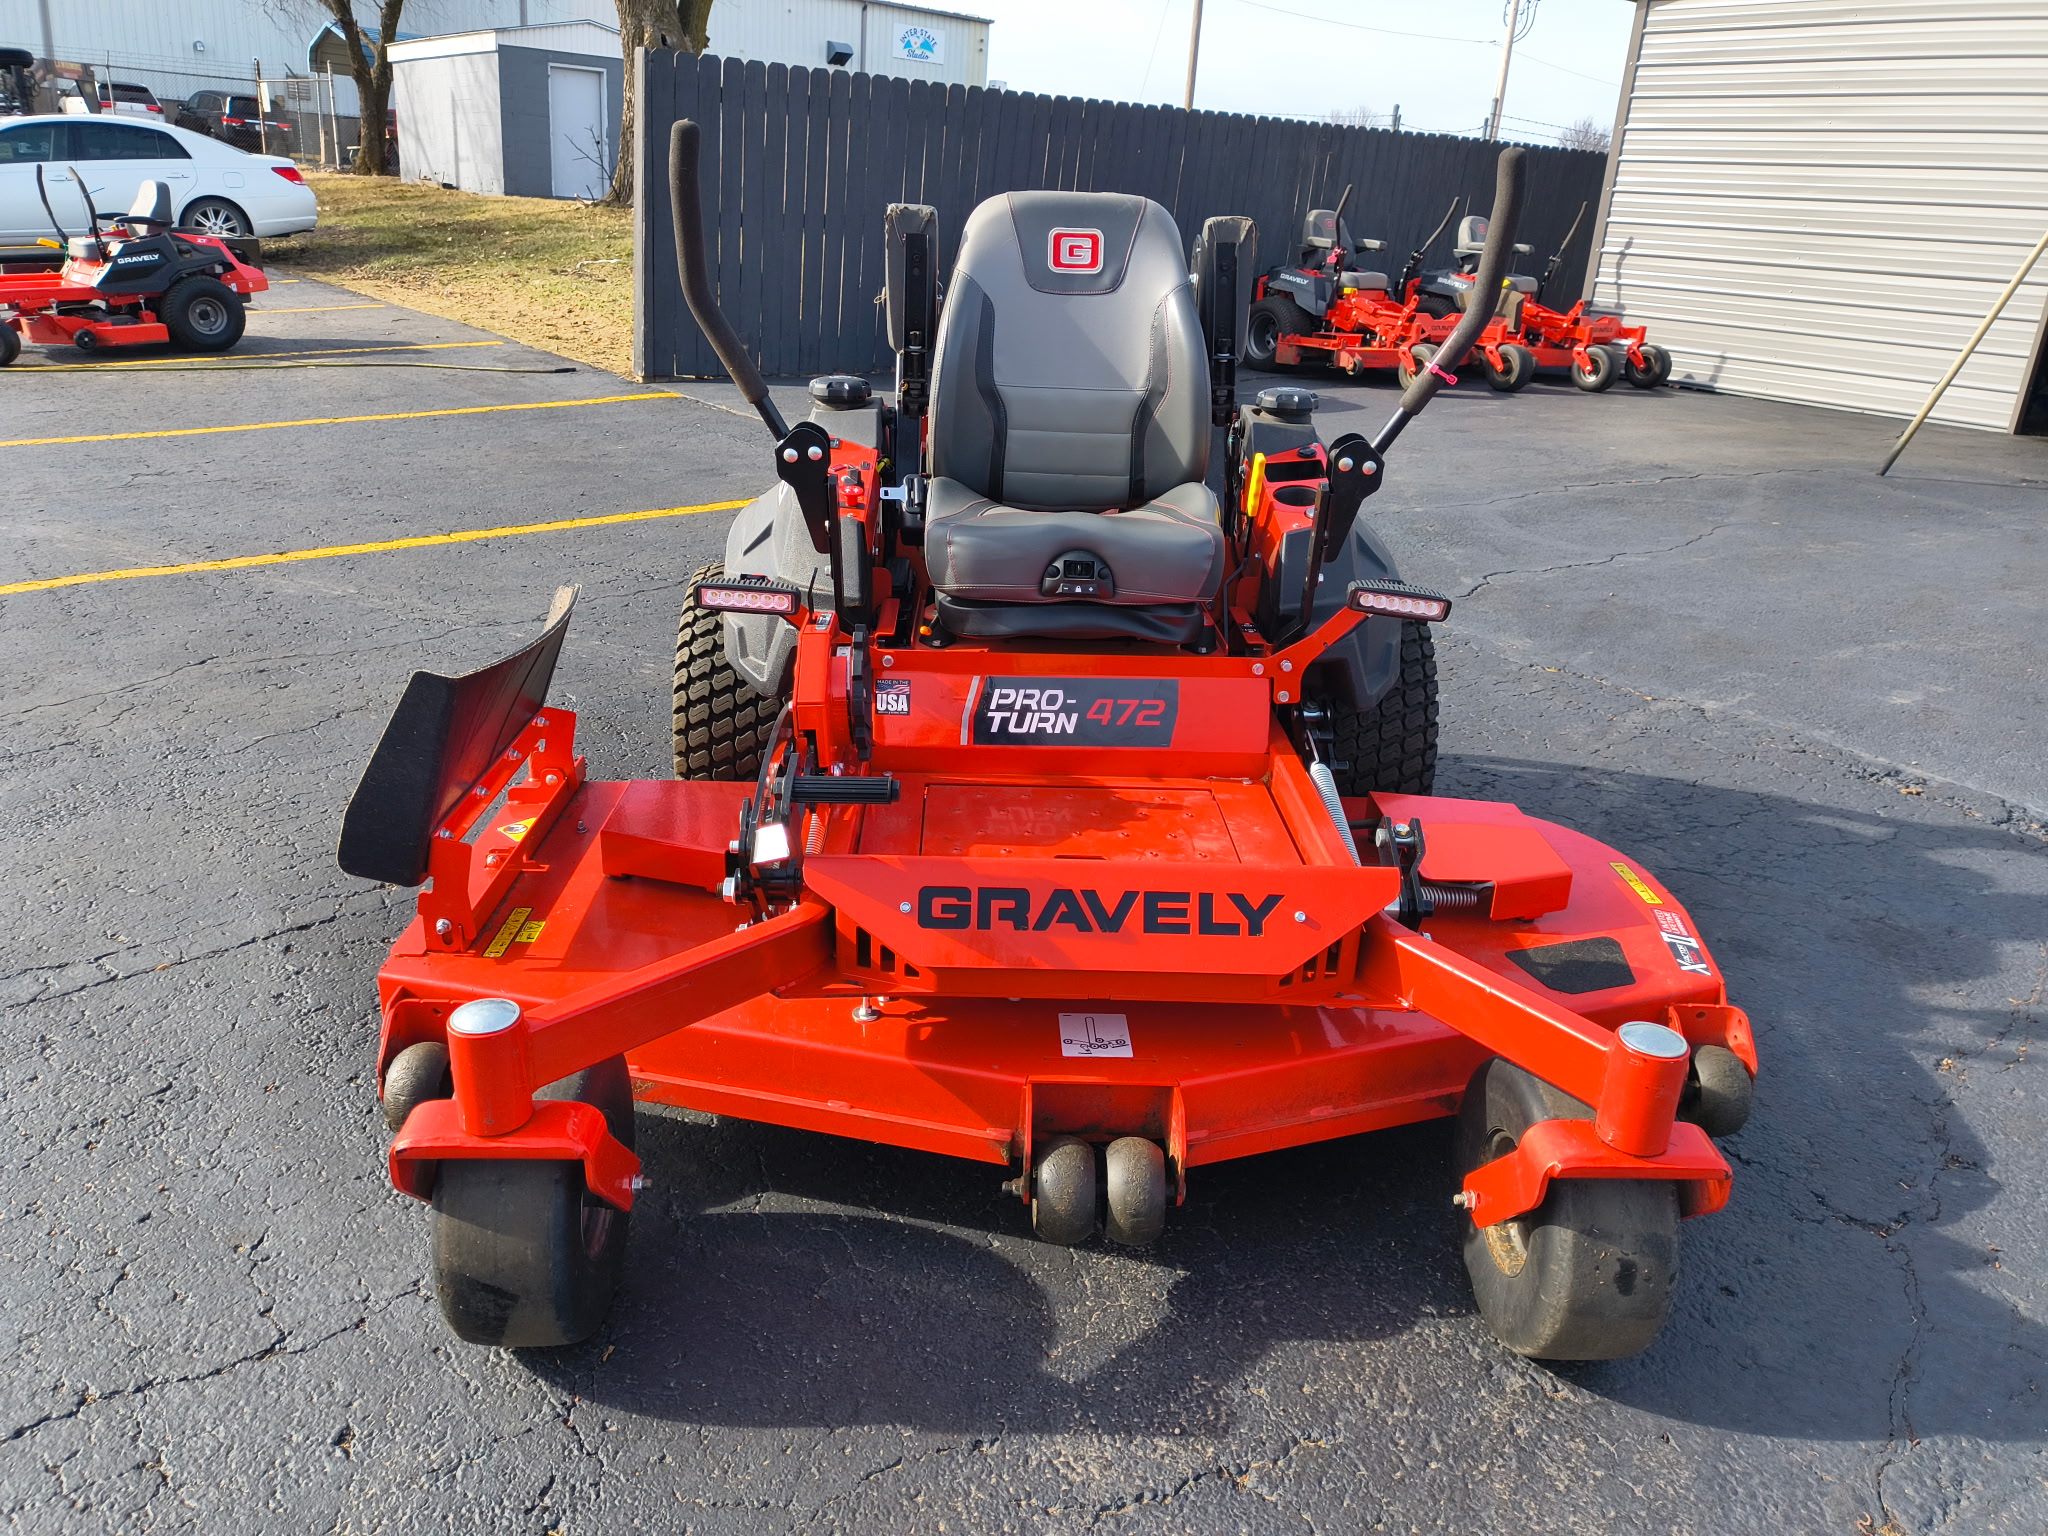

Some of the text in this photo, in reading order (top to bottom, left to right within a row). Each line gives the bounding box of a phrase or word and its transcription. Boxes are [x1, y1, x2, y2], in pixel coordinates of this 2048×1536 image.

[907, 49, 929, 60] Studio
[117, 253, 160, 265] GRAVELY
[1280, 272, 1309, 285] GRAVELY
[1437, 277, 1469, 289] GRAVELY
[877, 694, 909, 712] USA
[990, 688, 1077, 711] PRO-
[1086, 699, 1166, 726] 472
[987, 712, 1079, 734] TURN
[917, 885, 1286, 937] GRAVELY
